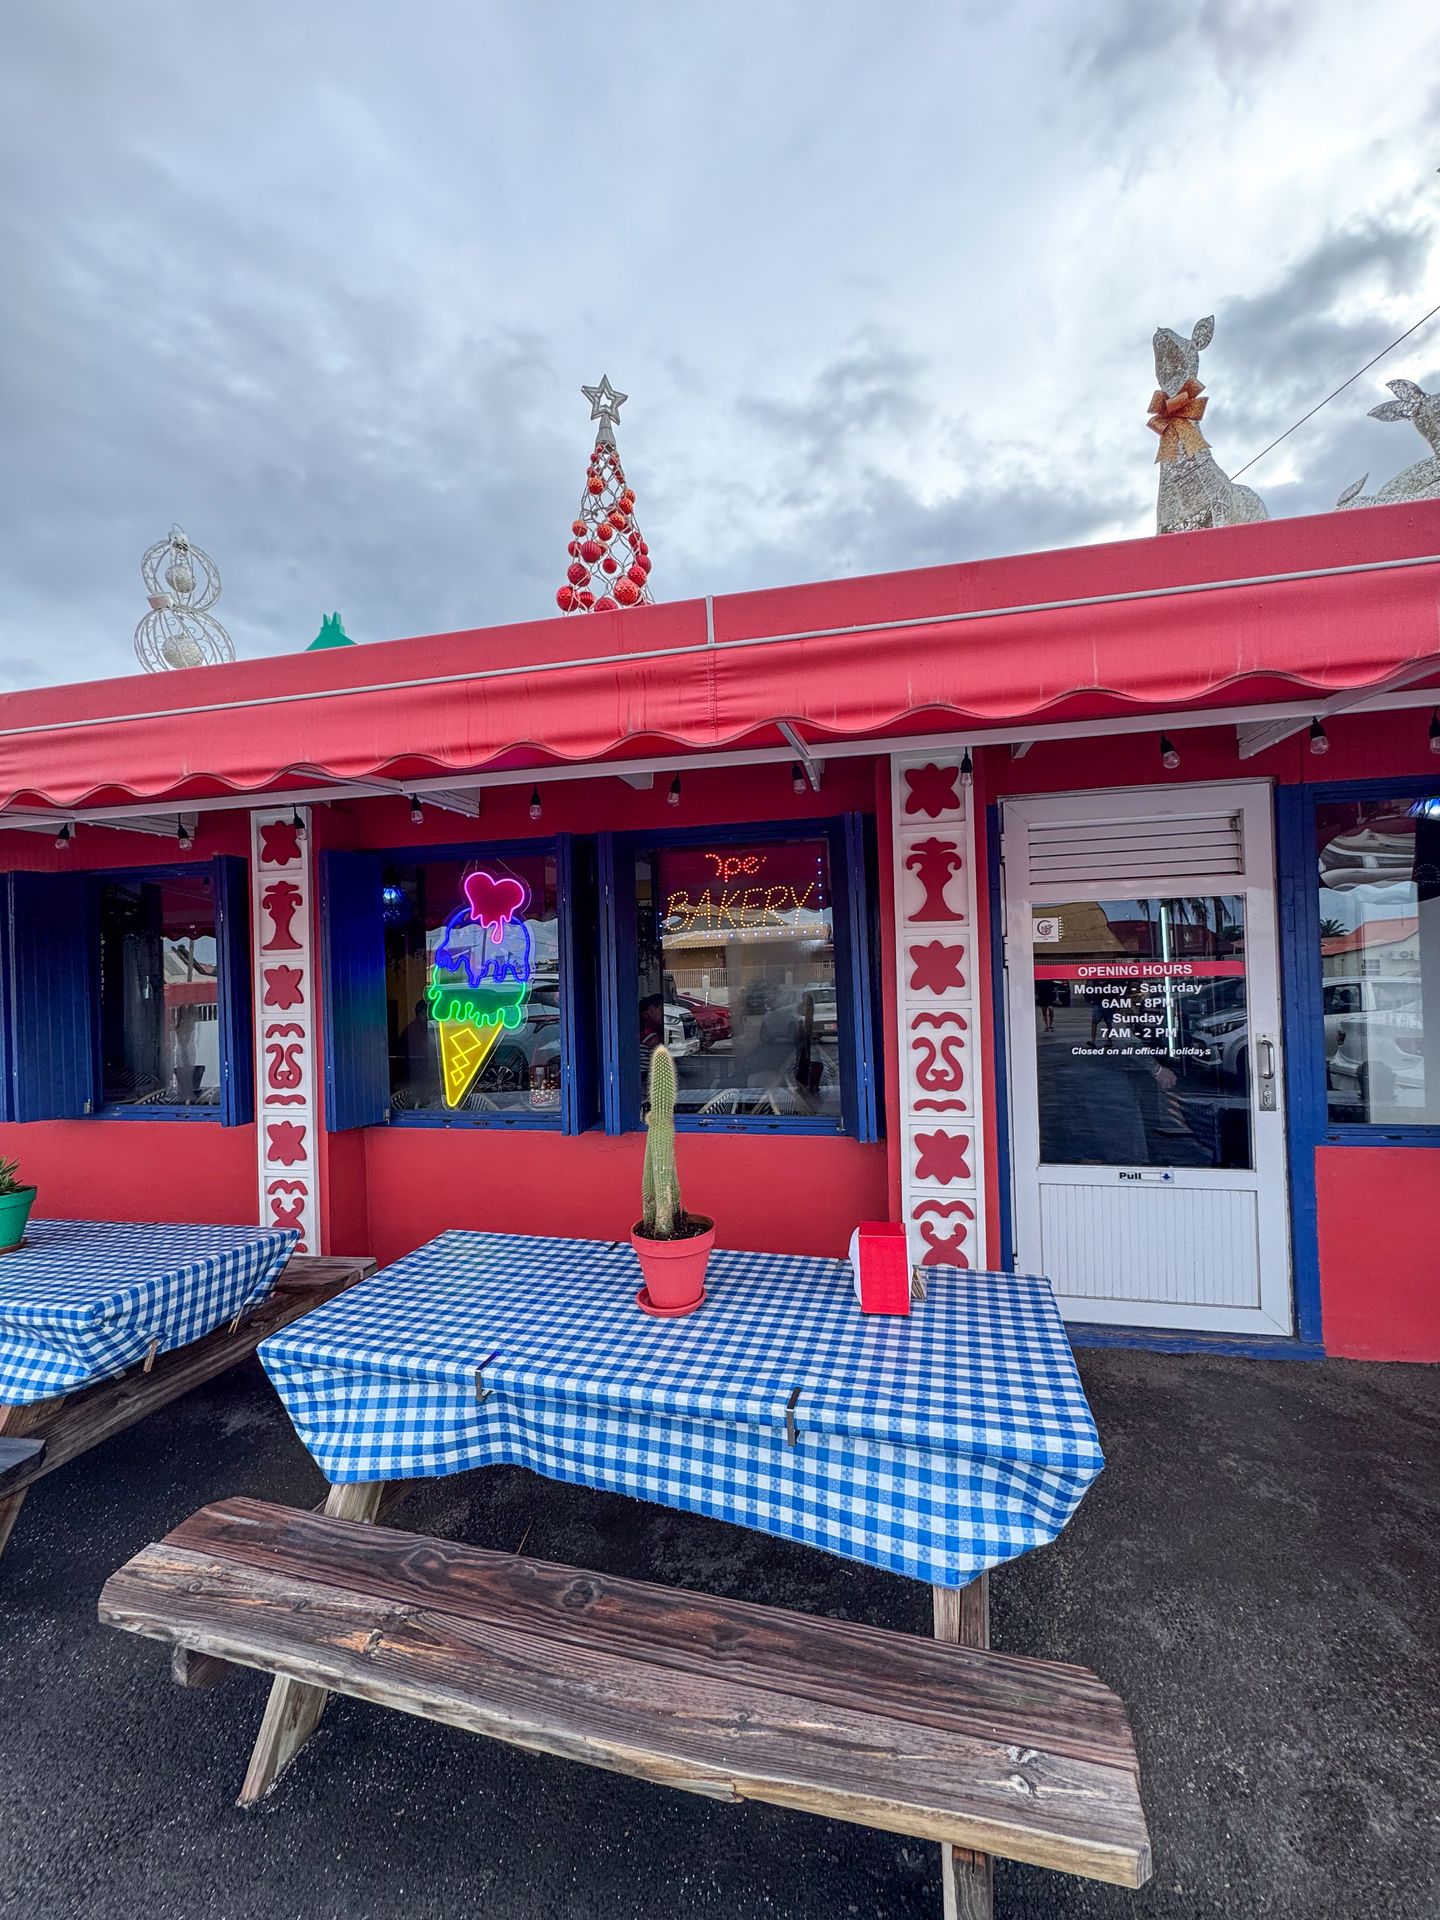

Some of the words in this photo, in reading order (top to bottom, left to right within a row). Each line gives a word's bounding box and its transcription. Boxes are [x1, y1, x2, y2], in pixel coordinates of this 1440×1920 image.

[705, 853, 767, 883] pe
[666, 882, 816, 931] BAKERY
[1077, 966, 1140, 977] OPENING
[1142, 964, 1193, 975] HOURS
[1074, 984, 1127, 996] Monday
[1140, 983, 1202, 994] Saturday
[1101, 998, 1132, 1009] 6AM
[1144, 998, 1175, 1008] 8PM
[1112, 1013, 1165, 1026] Sunday
[1100, 1028, 1131, 1038] 7AM
[1143, 1028, 1152, 1038] 2
[1155, 1028, 1178, 1038] PM
[1071, 1047, 1105, 1056] Closed
[1121, 1047, 1134, 1055] all
[1134, 1047, 1168, 1055] official
[1119, 1172, 1142, 1180] Pull
